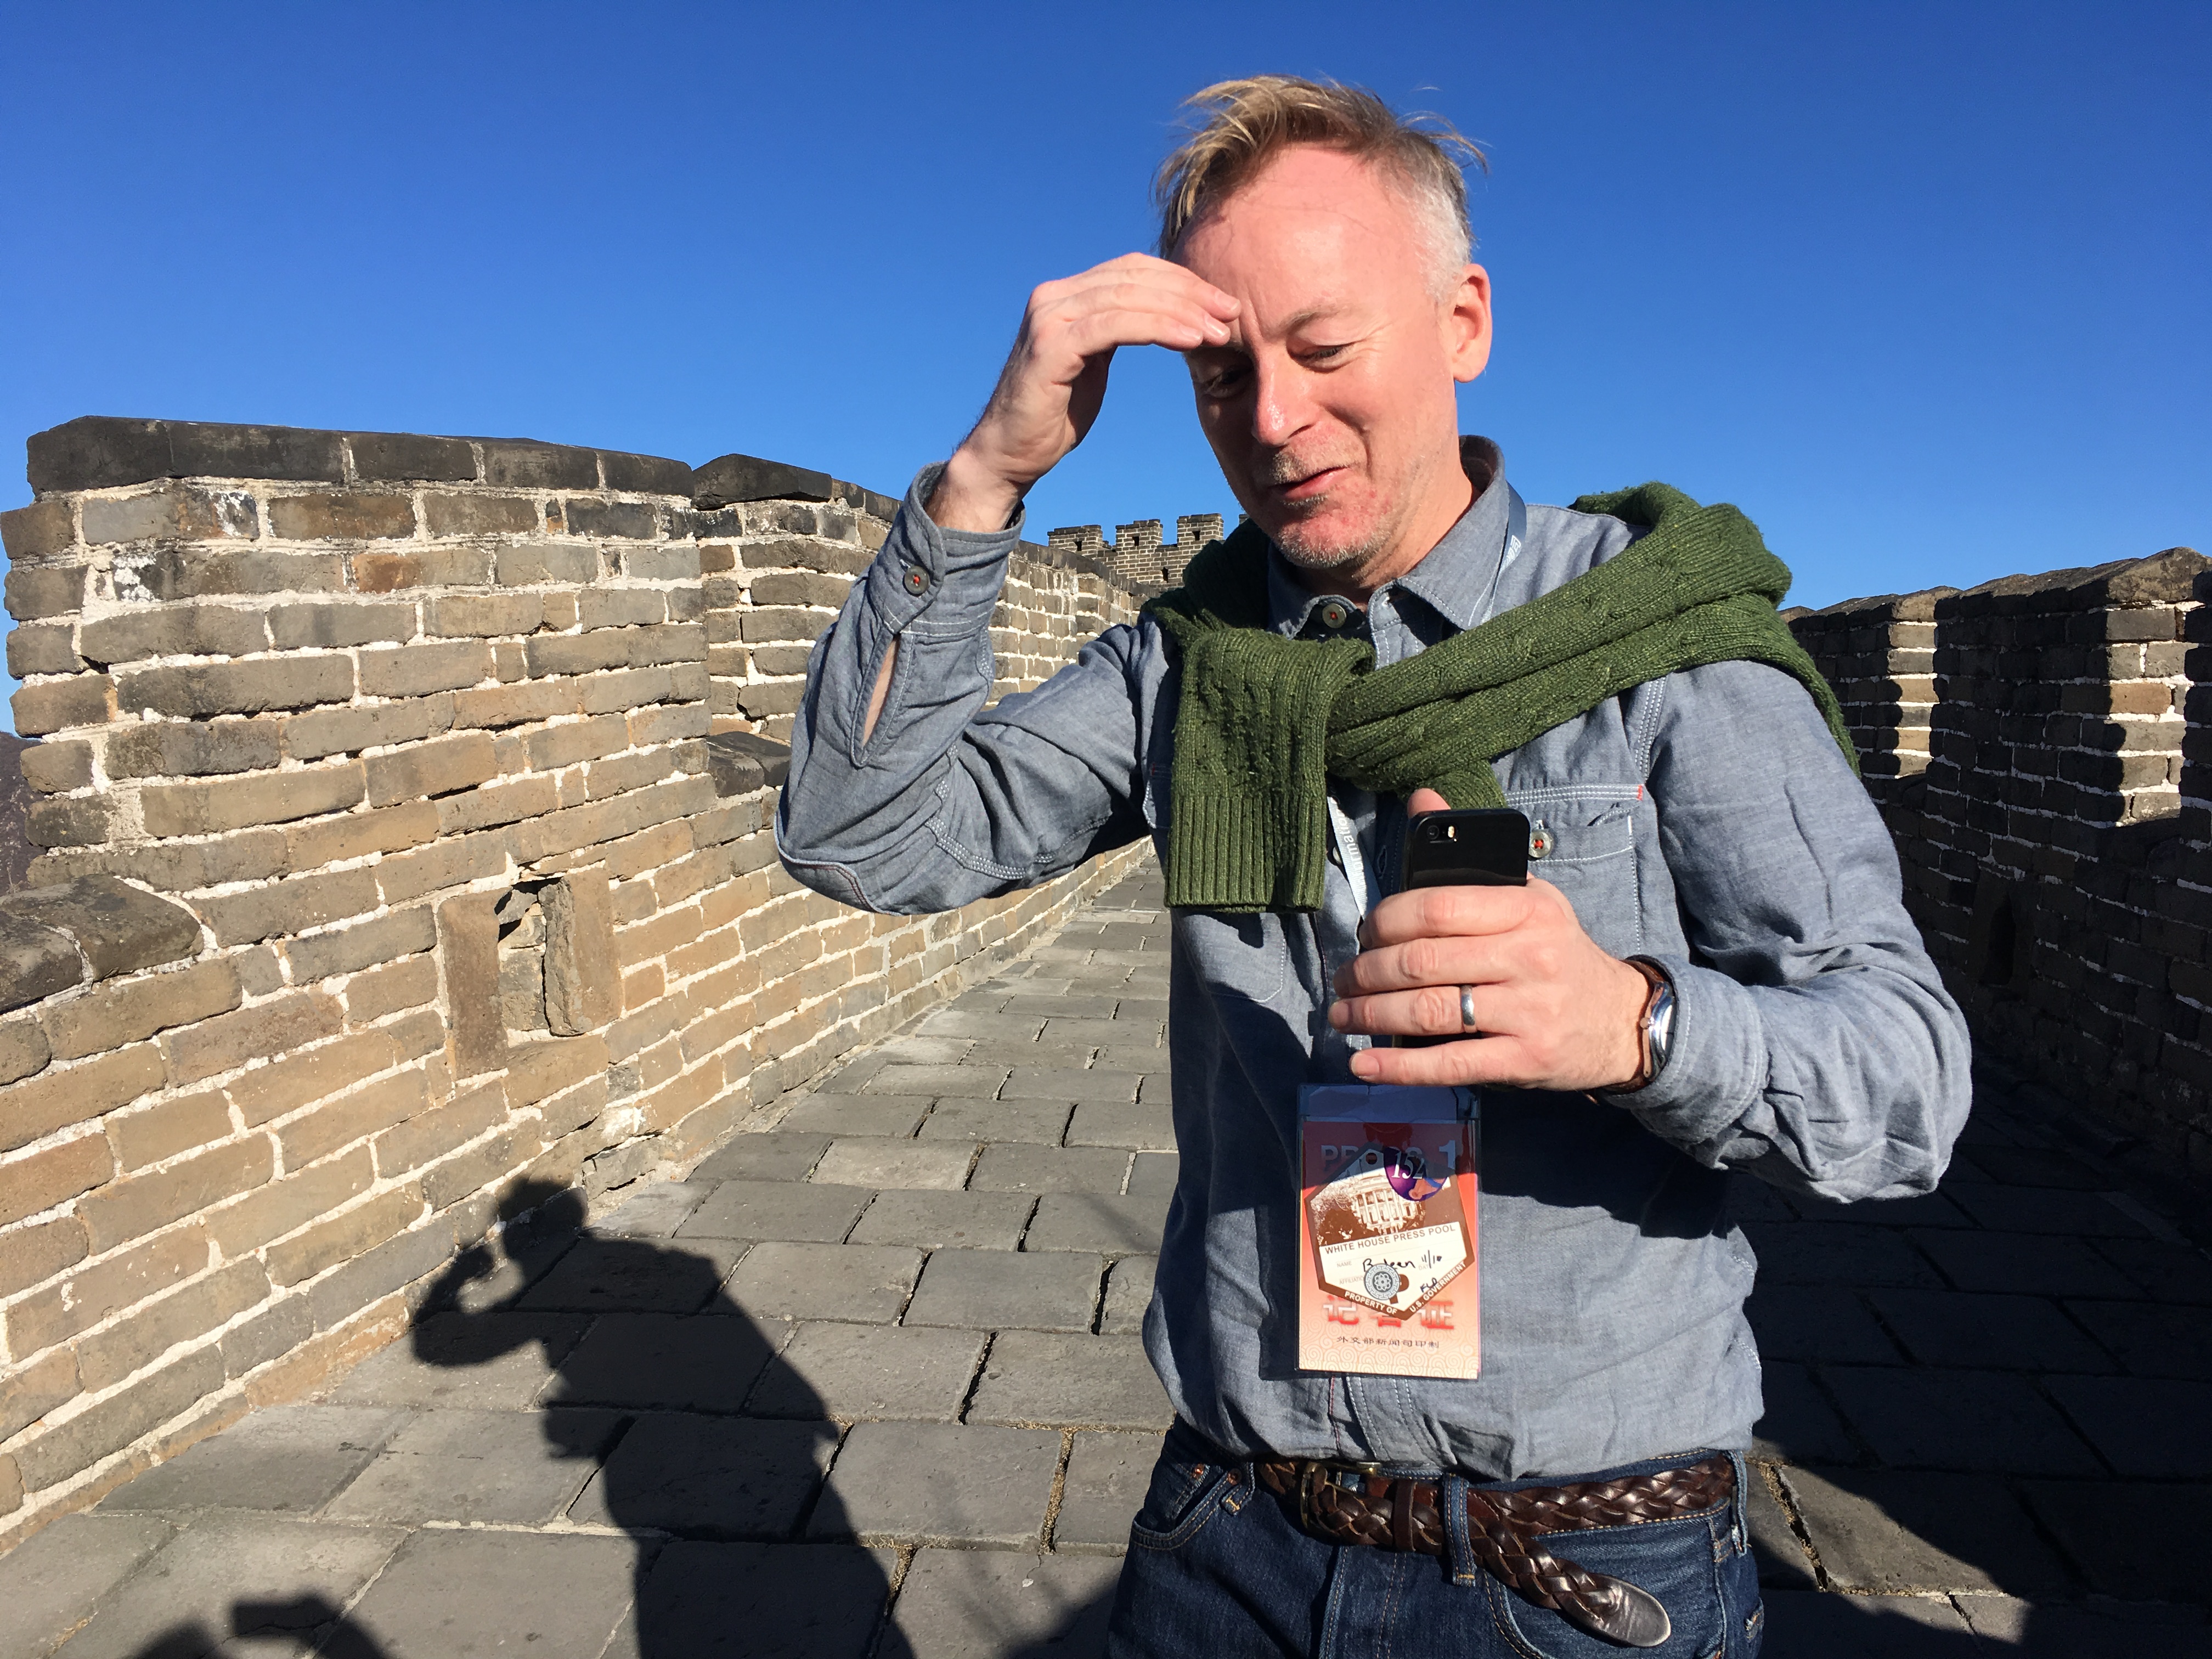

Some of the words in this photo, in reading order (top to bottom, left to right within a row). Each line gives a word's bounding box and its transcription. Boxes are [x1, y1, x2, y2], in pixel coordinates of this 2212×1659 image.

[1391, 1150, 1425, 1180] 152
[1325, 1243, 1355, 1255] WHITE
[1358, 1236, 1391, 1249] HOUSE
[1394, 1229, 1425, 1242] PRESS
[1429, 1224, 1455, 1235] POOL
[1339, 1276, 1365, 1285] AFFILIATIO
[1409, 1301, 1424, 1313] U.S.
[1423, 1261, 1466, 1301] GOVERNMENT
[1344, 1290, 1386, 1311] PROPERTY
[1386, 1306, 1398, 1315] OF
[1336, 1336, 1440, 1348] 外交部新闻司印制
